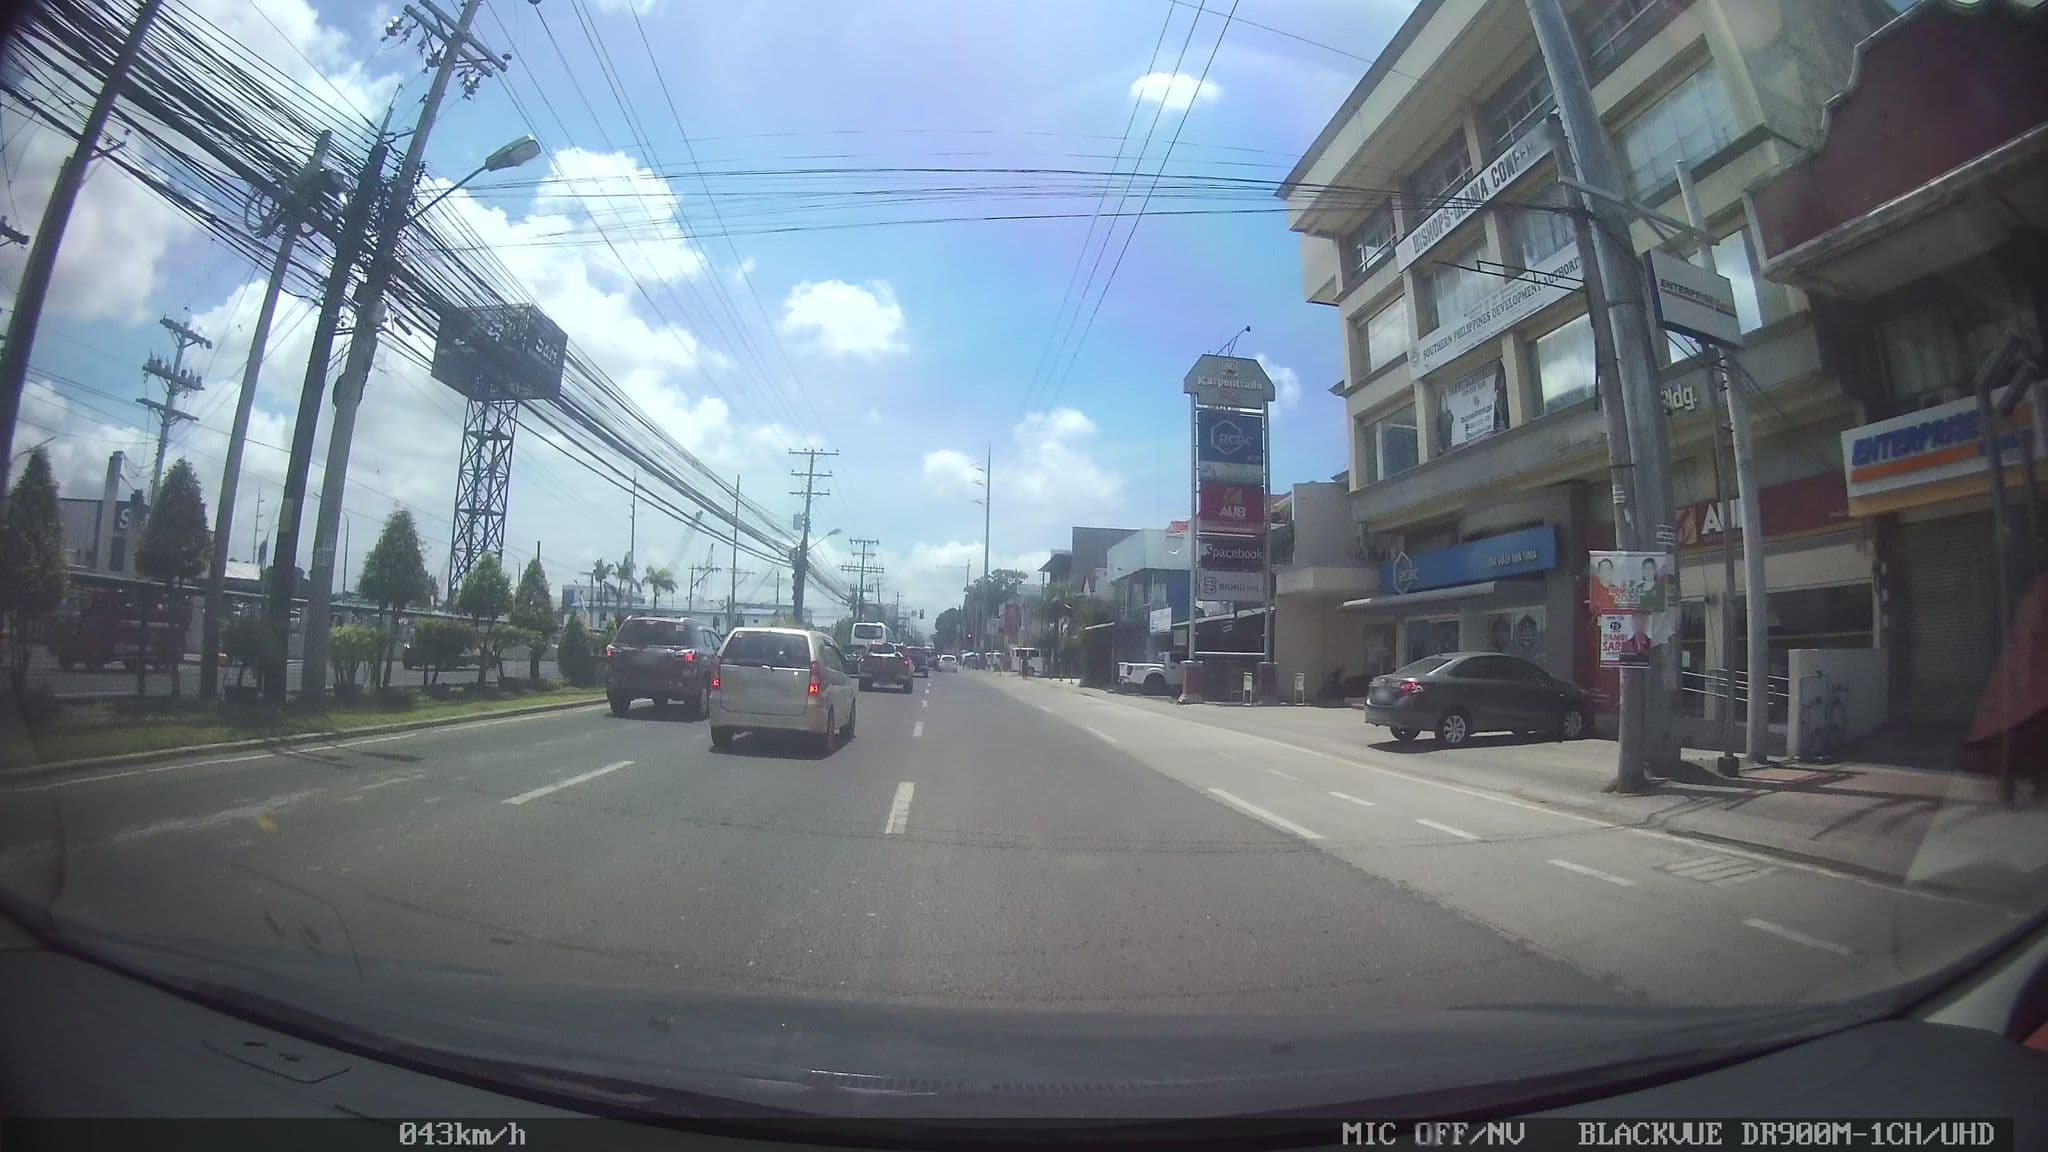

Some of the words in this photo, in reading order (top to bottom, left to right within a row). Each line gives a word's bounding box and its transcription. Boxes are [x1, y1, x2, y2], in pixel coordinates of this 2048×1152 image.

[1412, 177, 1489, 254] BISHOPS-ULAMA
[1422, 334, 1453, 360] SOUTHERN
[1453, 310, 1491, 342] PHILIPPINES
[1219, 505, 1246, 518] AUB
[1206, 543, 1265, 561] Spacebook
